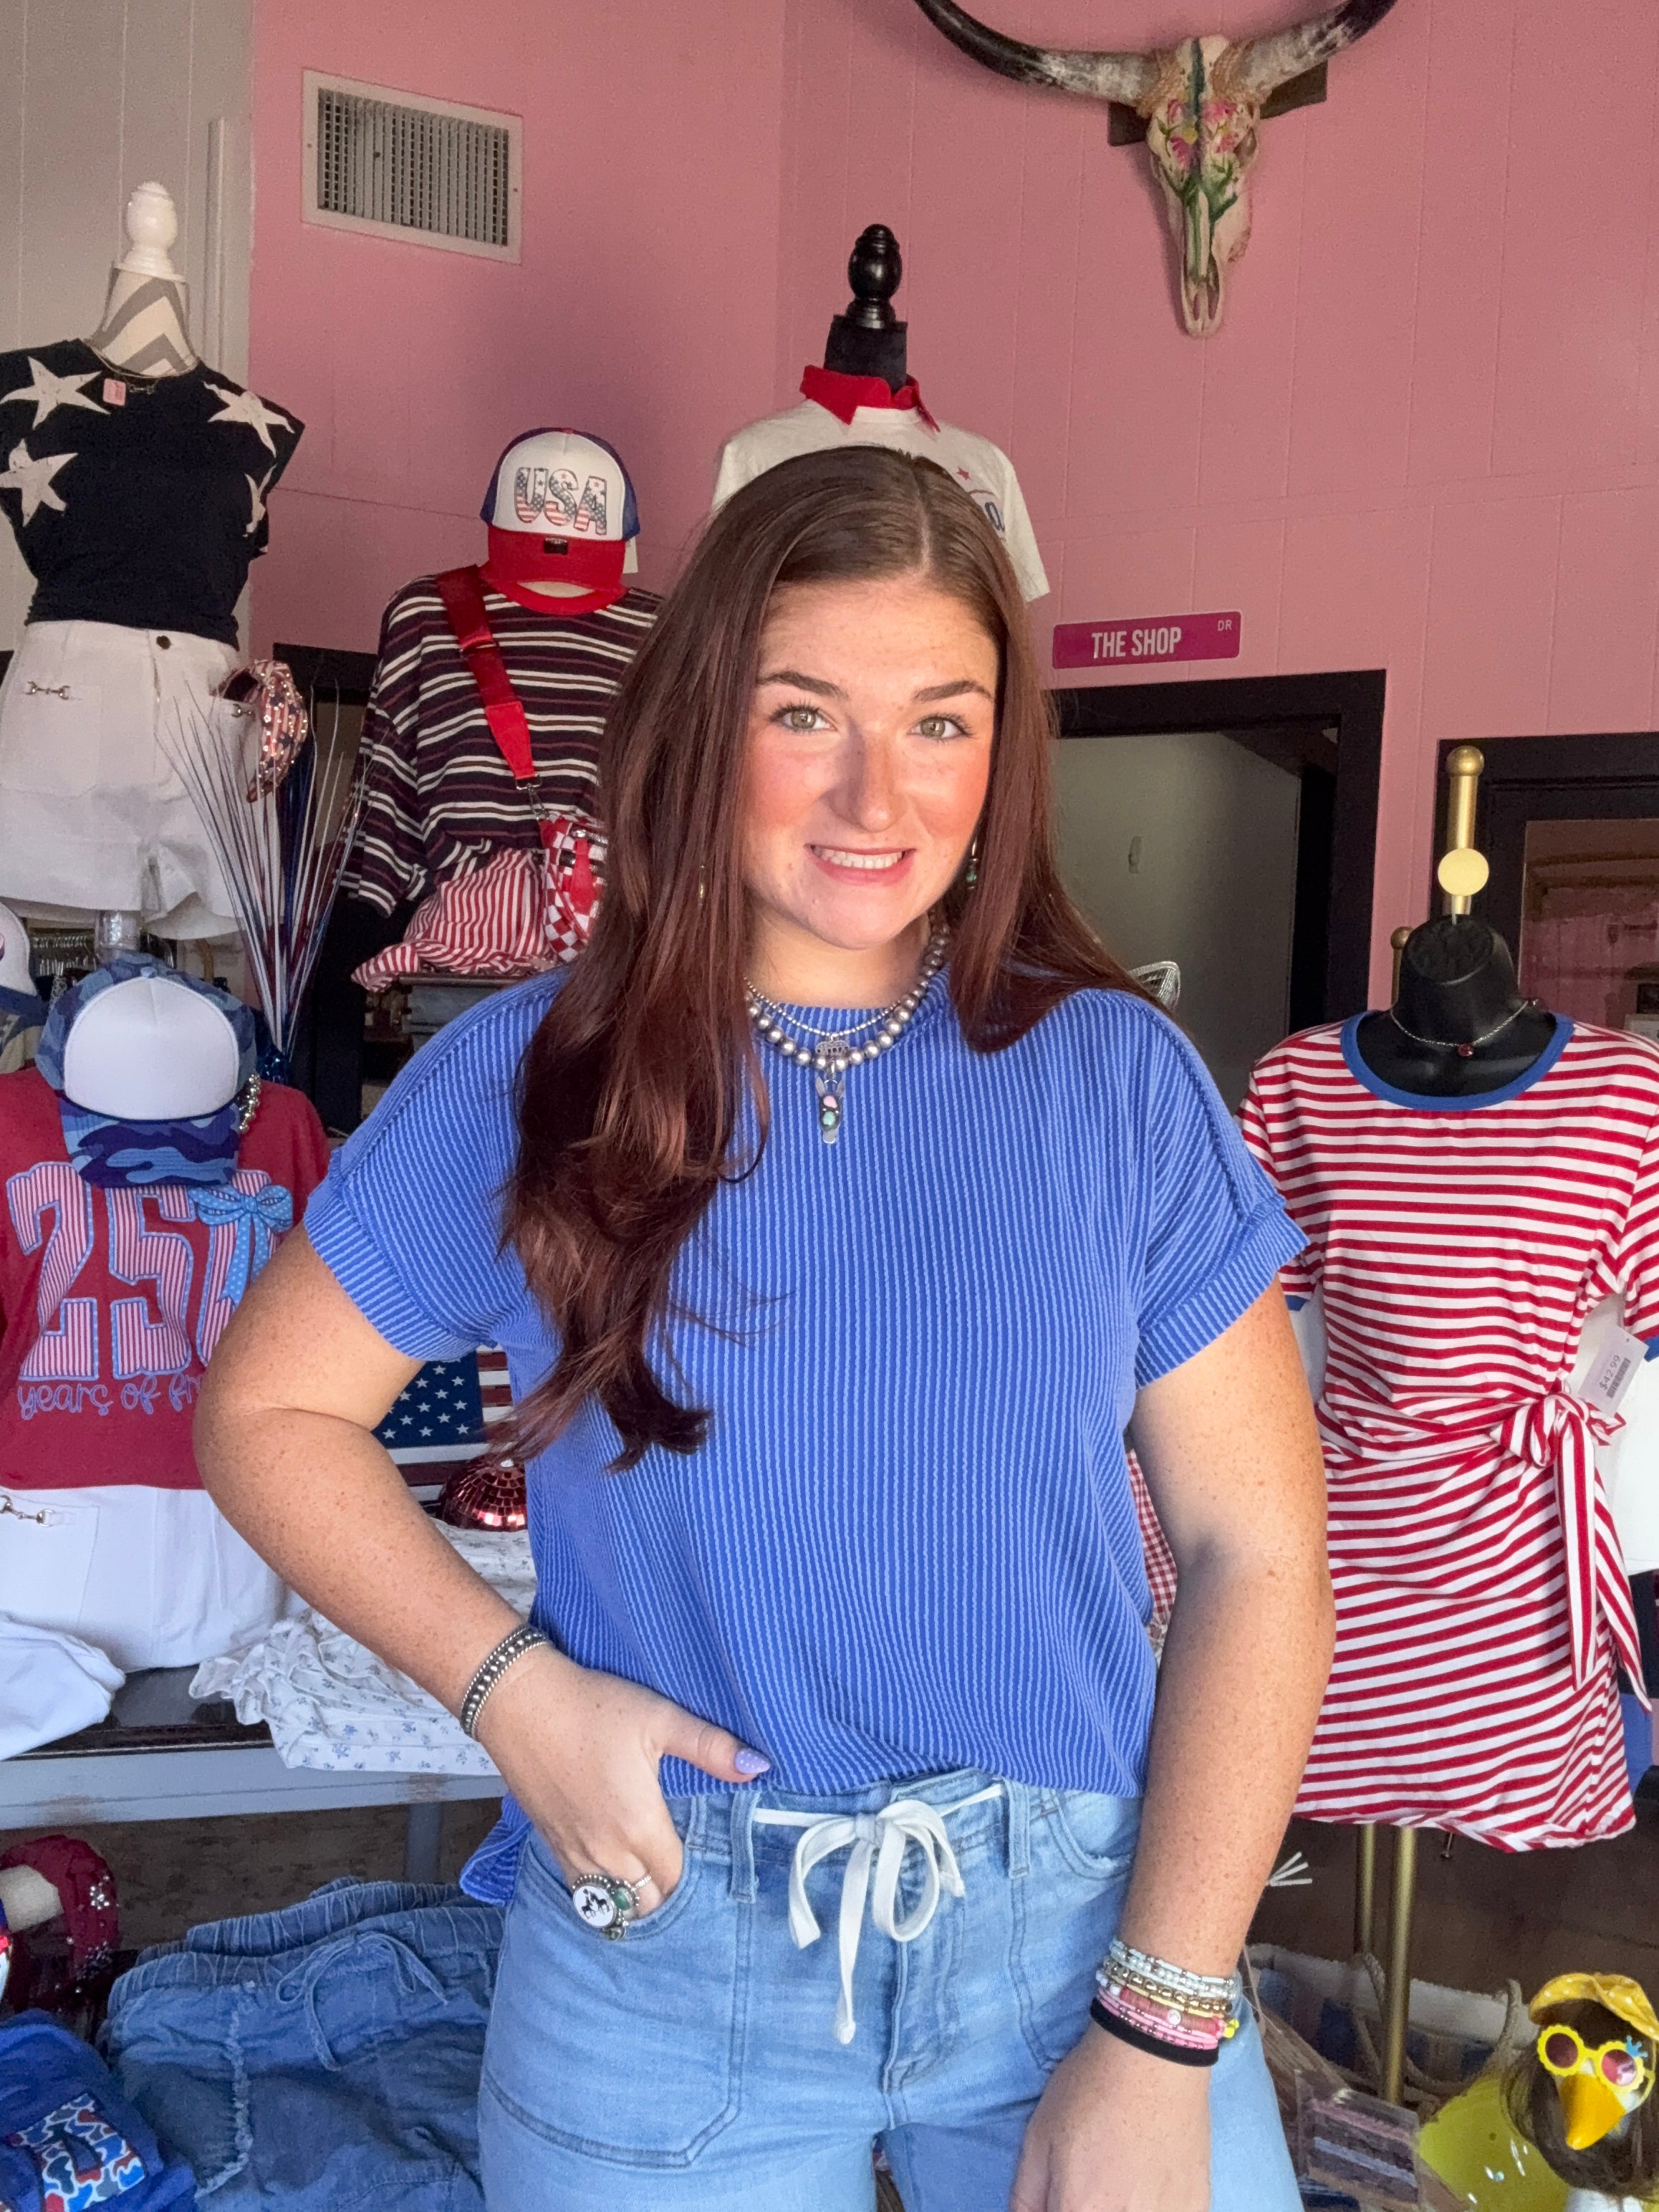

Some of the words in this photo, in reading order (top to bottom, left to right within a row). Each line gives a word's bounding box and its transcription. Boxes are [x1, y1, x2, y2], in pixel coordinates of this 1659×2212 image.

[515, 467, 607, 535] USA
[1092, 631, 1127, 658] THE
[1131, 627, 1182, 656] SHOP
[1218, 619, 1232, 631] DR
[18, 1383, 114, 1420] years
[120, 1373, 161, 1415] of
